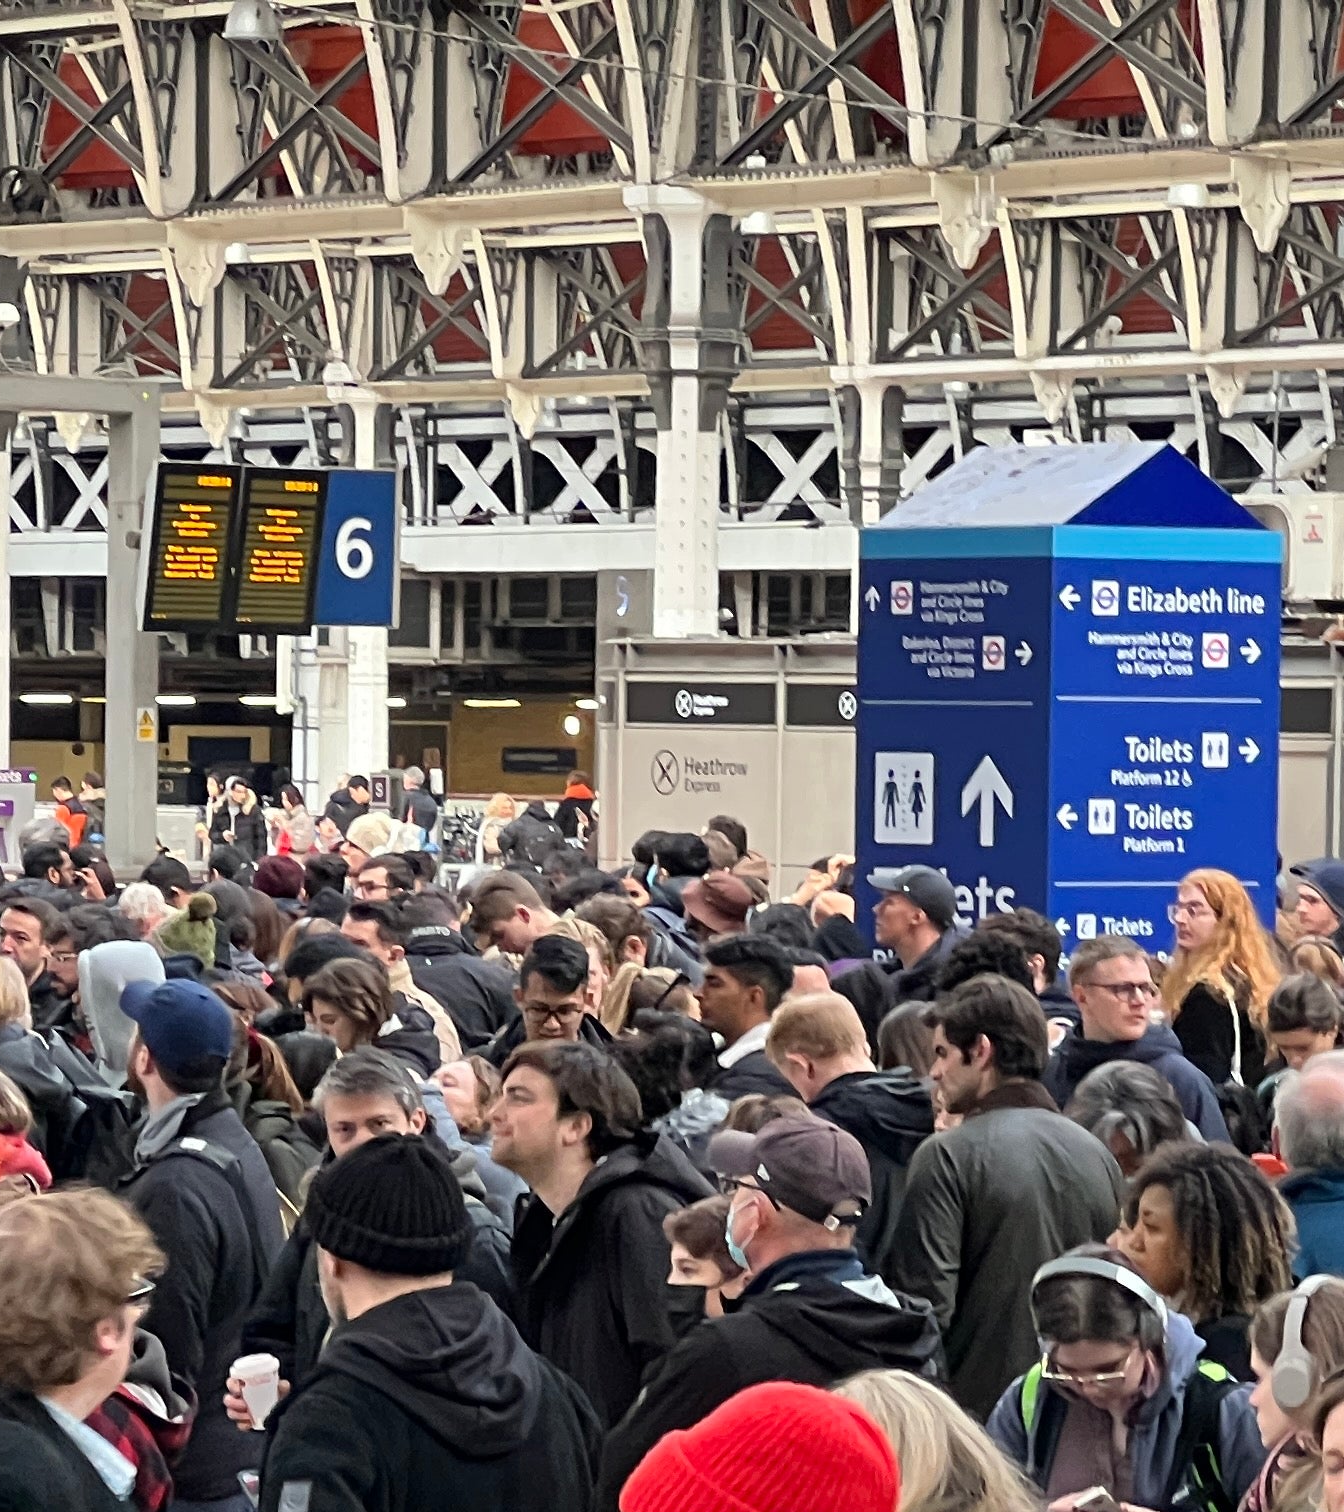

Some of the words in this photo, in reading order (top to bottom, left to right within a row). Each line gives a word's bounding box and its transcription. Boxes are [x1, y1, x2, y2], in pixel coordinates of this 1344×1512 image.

[335, 517, 373, 579] 6
[1127, 586, 1223, 613] Elizabeth
[1227, 587, 1264, 614] line
[1171, 632, 1193, 649] City
[1137, 646, 1167, 660] Circle
[1124, 736, 1194, 763] Toilets
[683, 757, 748, 777] Heathrow
[1111, 769, 1162, 786] Platform
[1164, 769, 1180, 786] 12
[1124, 803, 1193, 830] Toilets
[1123, 836, 1174, 852] Platform
[1176, 836, 1185, 853] 1
[1101, 917, 1154, 936] Tickets
